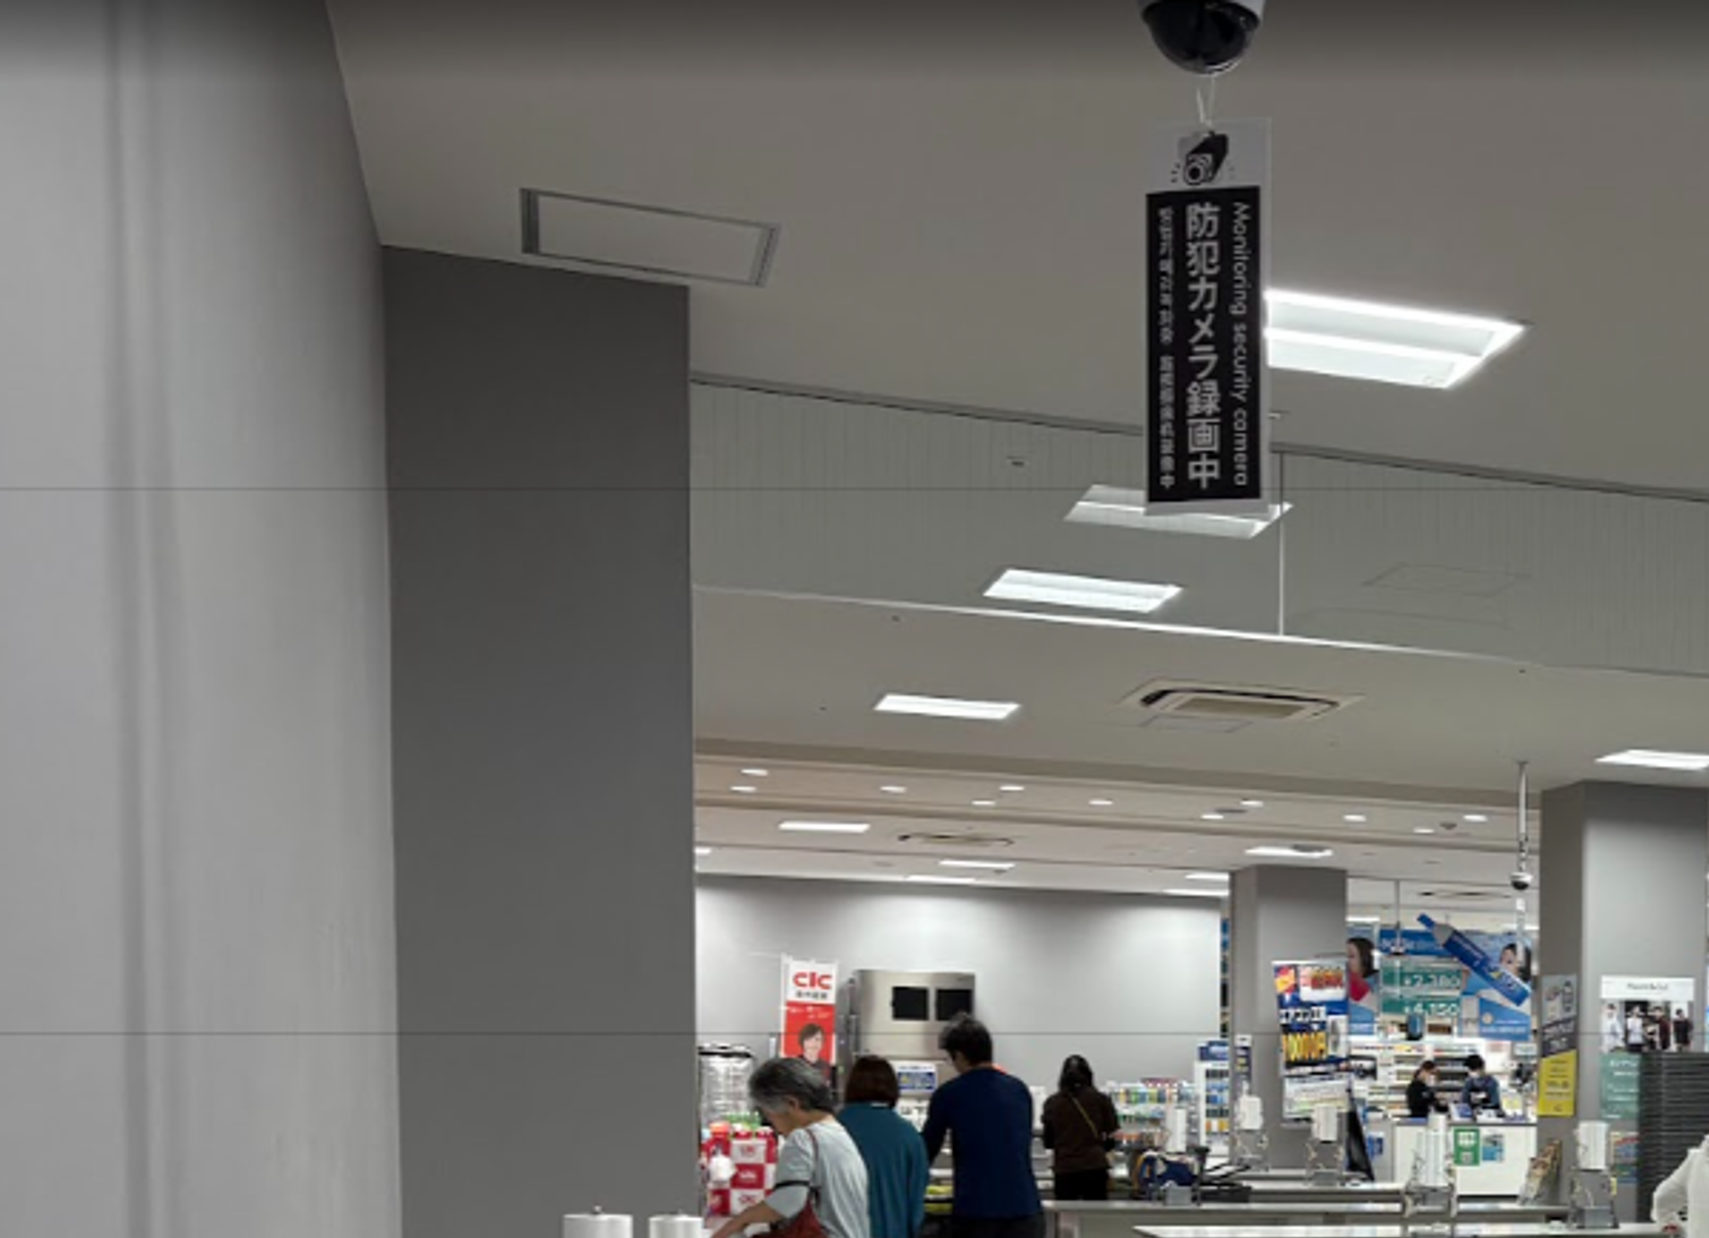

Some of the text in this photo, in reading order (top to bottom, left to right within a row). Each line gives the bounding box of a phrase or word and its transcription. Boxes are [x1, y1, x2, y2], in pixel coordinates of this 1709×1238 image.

[1185, 202, 1221, 489] 防犯カメラ録画中
[1229, 202, 1251, 487] Monitoring security camera
